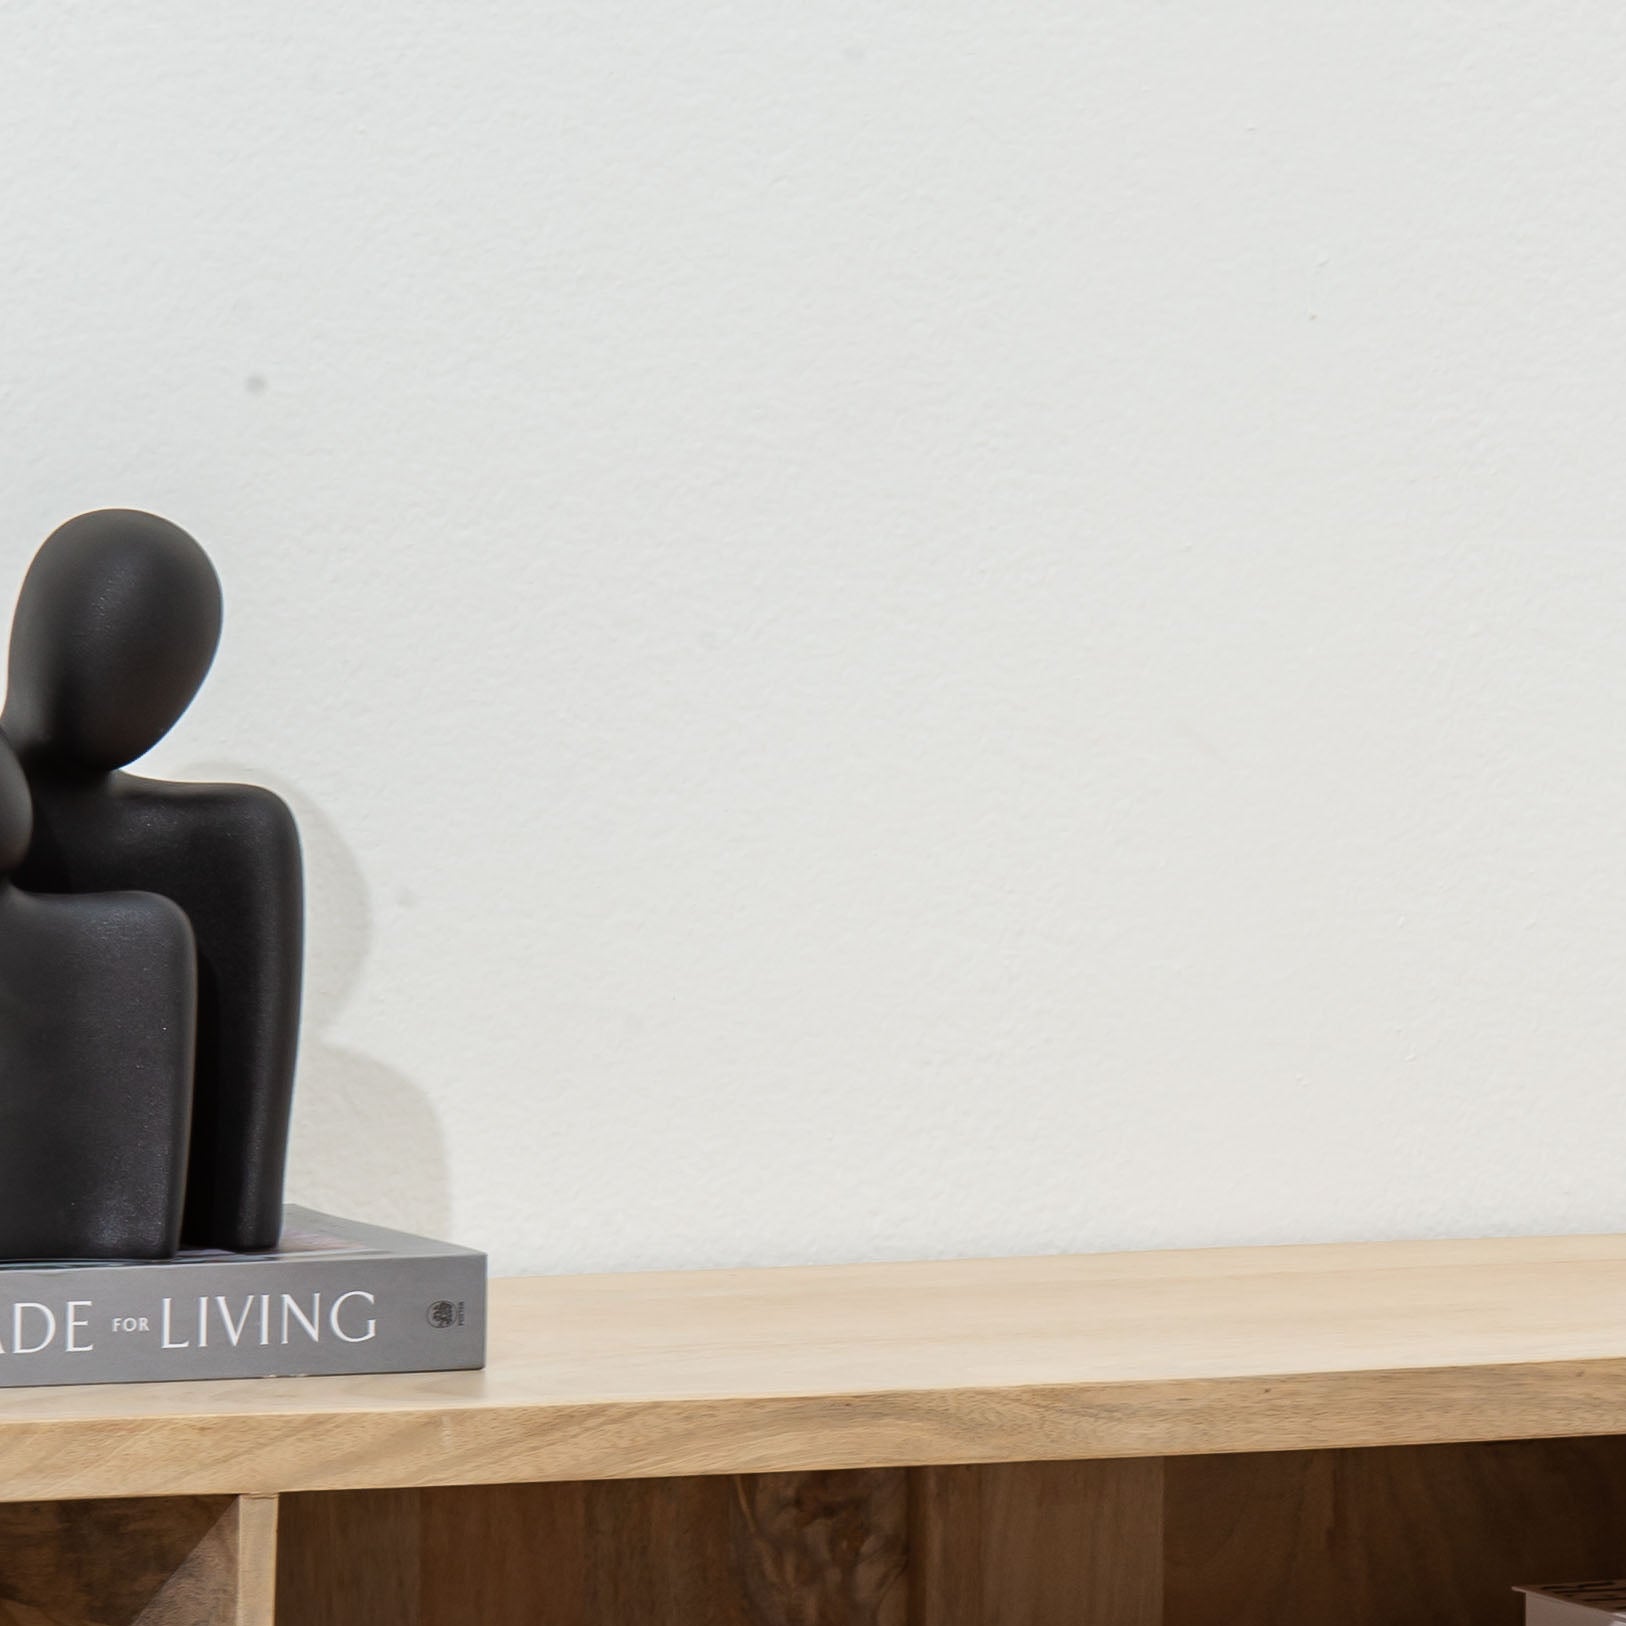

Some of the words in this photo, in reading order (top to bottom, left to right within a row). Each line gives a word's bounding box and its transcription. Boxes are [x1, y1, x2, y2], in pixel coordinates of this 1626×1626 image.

[0, 1301, 93, 1354] DE
[112, 1317, 150, 1333] FOR
[161, 1291, 376, 1349] LIVING
